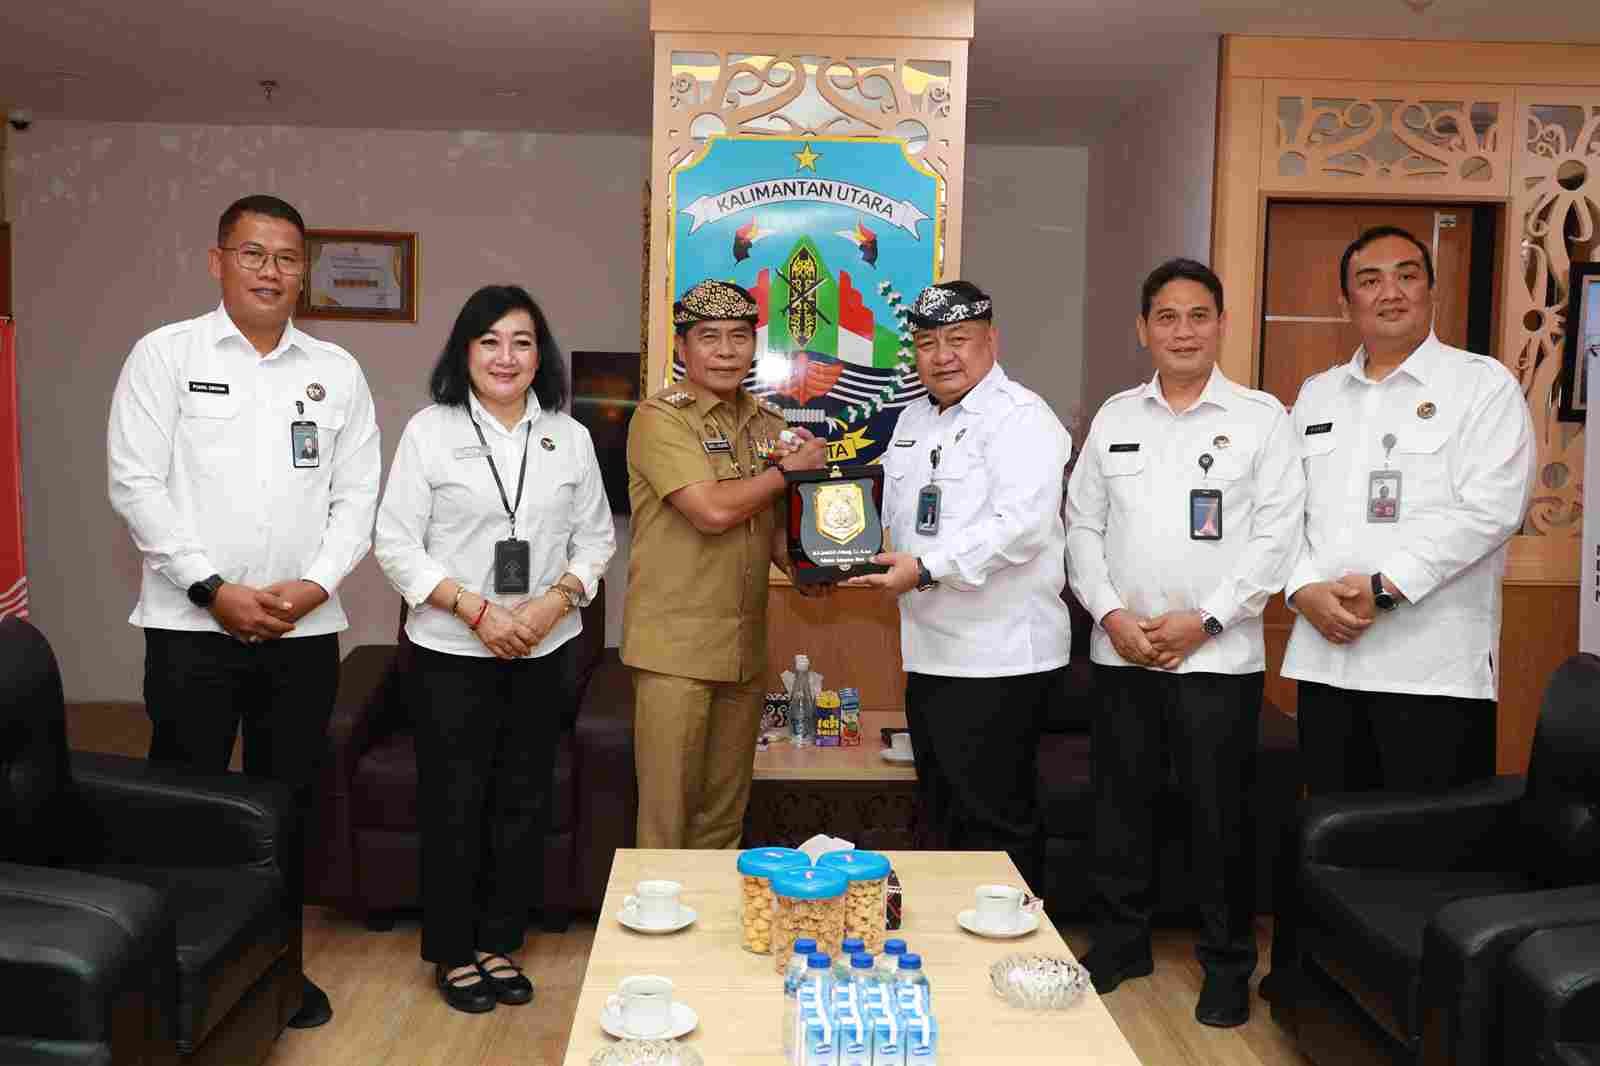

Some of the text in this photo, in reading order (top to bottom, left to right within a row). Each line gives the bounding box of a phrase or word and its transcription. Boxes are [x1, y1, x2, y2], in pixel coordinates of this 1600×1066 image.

[717, 180, 893, 217] KALIMANTAN UTARA
[826, 443, 849, 458] TA
